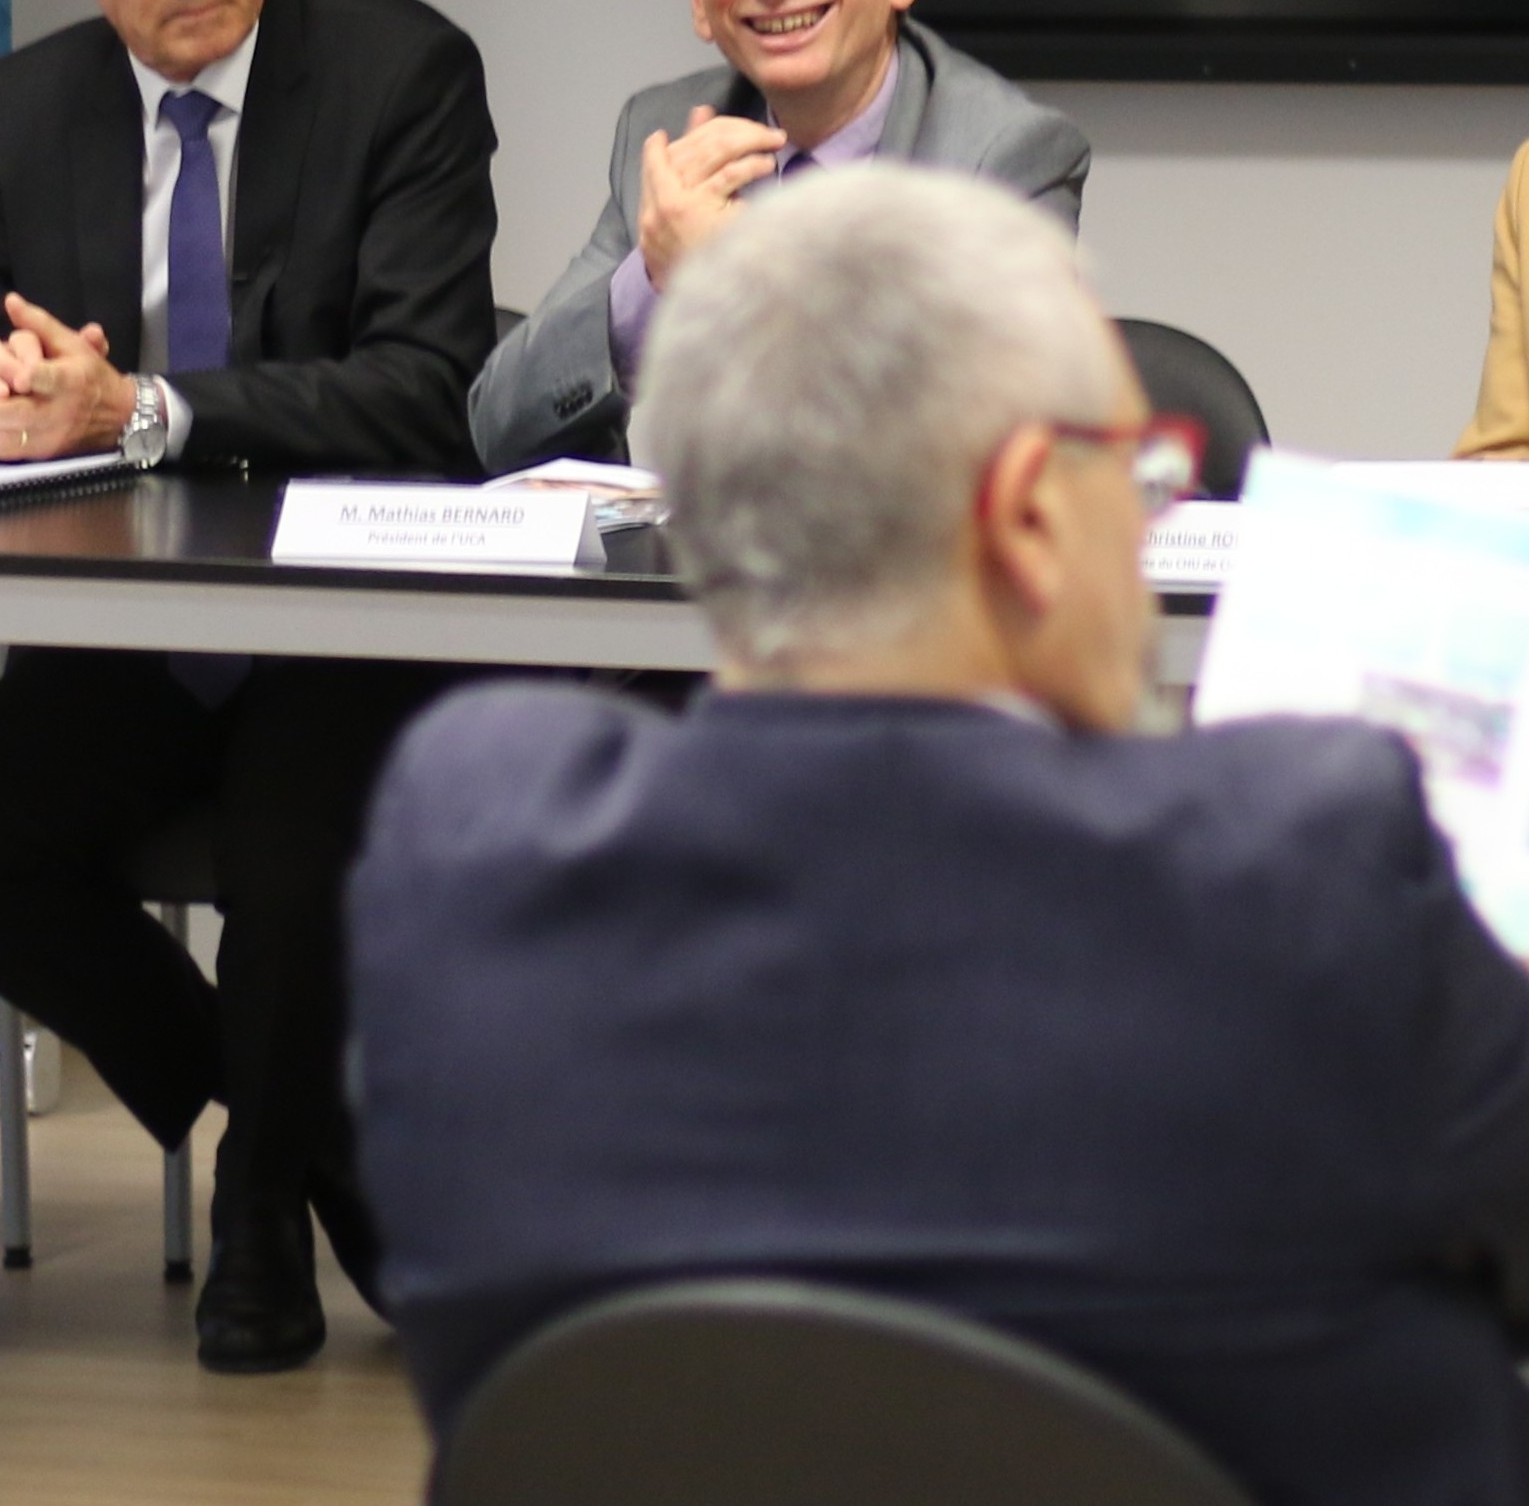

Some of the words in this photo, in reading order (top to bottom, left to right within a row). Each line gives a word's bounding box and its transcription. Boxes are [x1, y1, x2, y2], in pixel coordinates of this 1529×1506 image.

[340, 505, 361, 523] M.
[368, 505, 436, 523] Mathias
[441, 506, 525, 524] BERNARD
[368, 532, 428, 545] Président
[432, 533, 447, 545] de
